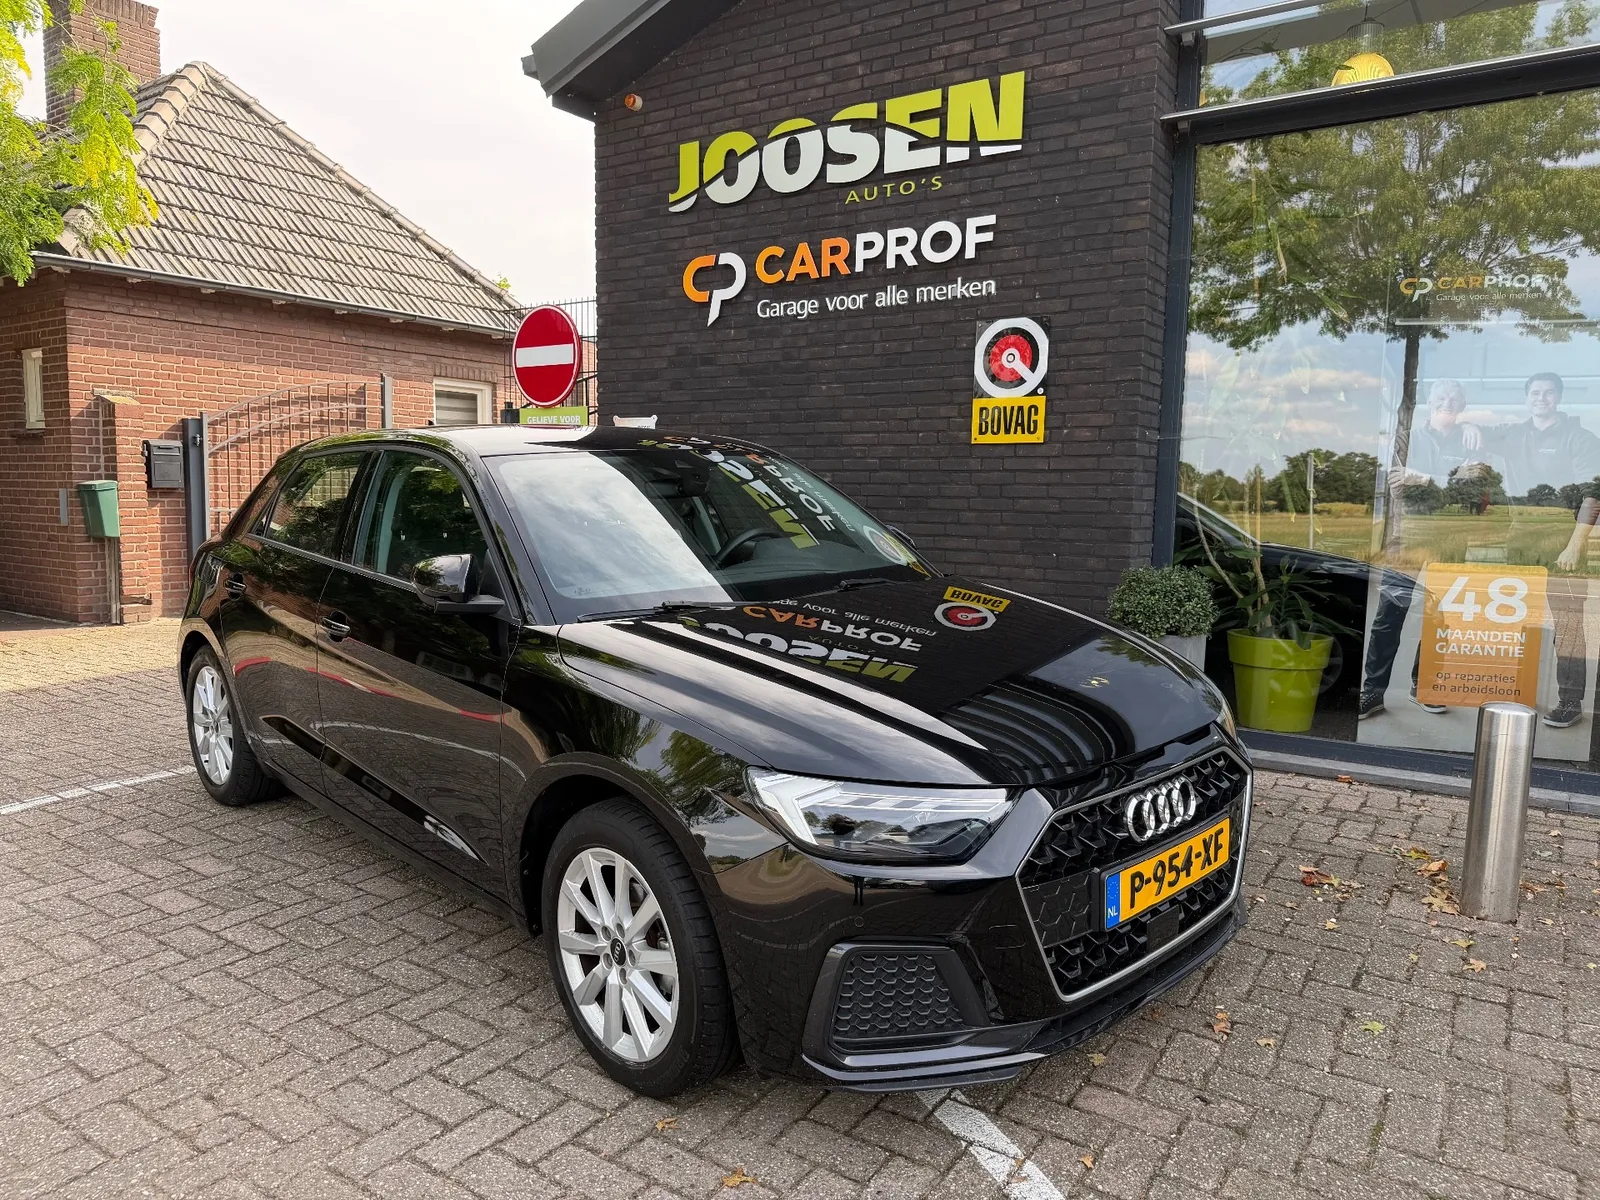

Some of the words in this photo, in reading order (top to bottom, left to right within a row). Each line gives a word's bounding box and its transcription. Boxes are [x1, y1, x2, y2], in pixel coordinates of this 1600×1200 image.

[668, 71, 1026, 213] JOOSEN
[845, 175, 943, 205] AUTO'S
[755, 214, 997, 285] CARPROF
[1437, 273, 1547, 290] CARPROF
[757, 297, 819, 319] Garage
[825, 292, 868, 312] voor
[875, 285, 908, 308] alle
[916, 277, 997, 303] merken
[1436, 292, 1466, 303] Garage
[1492, 292, 1507, 300] alle
[1509, 291, 1543, 300] merken
[527, 415, 558, 425] GELIEVE
[559, 414, 581, 424] VOOR
[977, 404, 1039, 436] BOVAG
[1437, 576, 1529, 624] 48
[1436, 627, 1526, 644] MAANDEN
[1435, 642, 1525, 658] GARANTIE
[1436, 671, 1451, 681] op
[1455, 671, 1516, 684] reparaties
[1432, 683, 1447, 692] en
[1450, 683, 1521, 697] arbeidsloon
[1129, 827, 1224, 910] P-954-XF
[1107, 904, 1119, 919] NL
